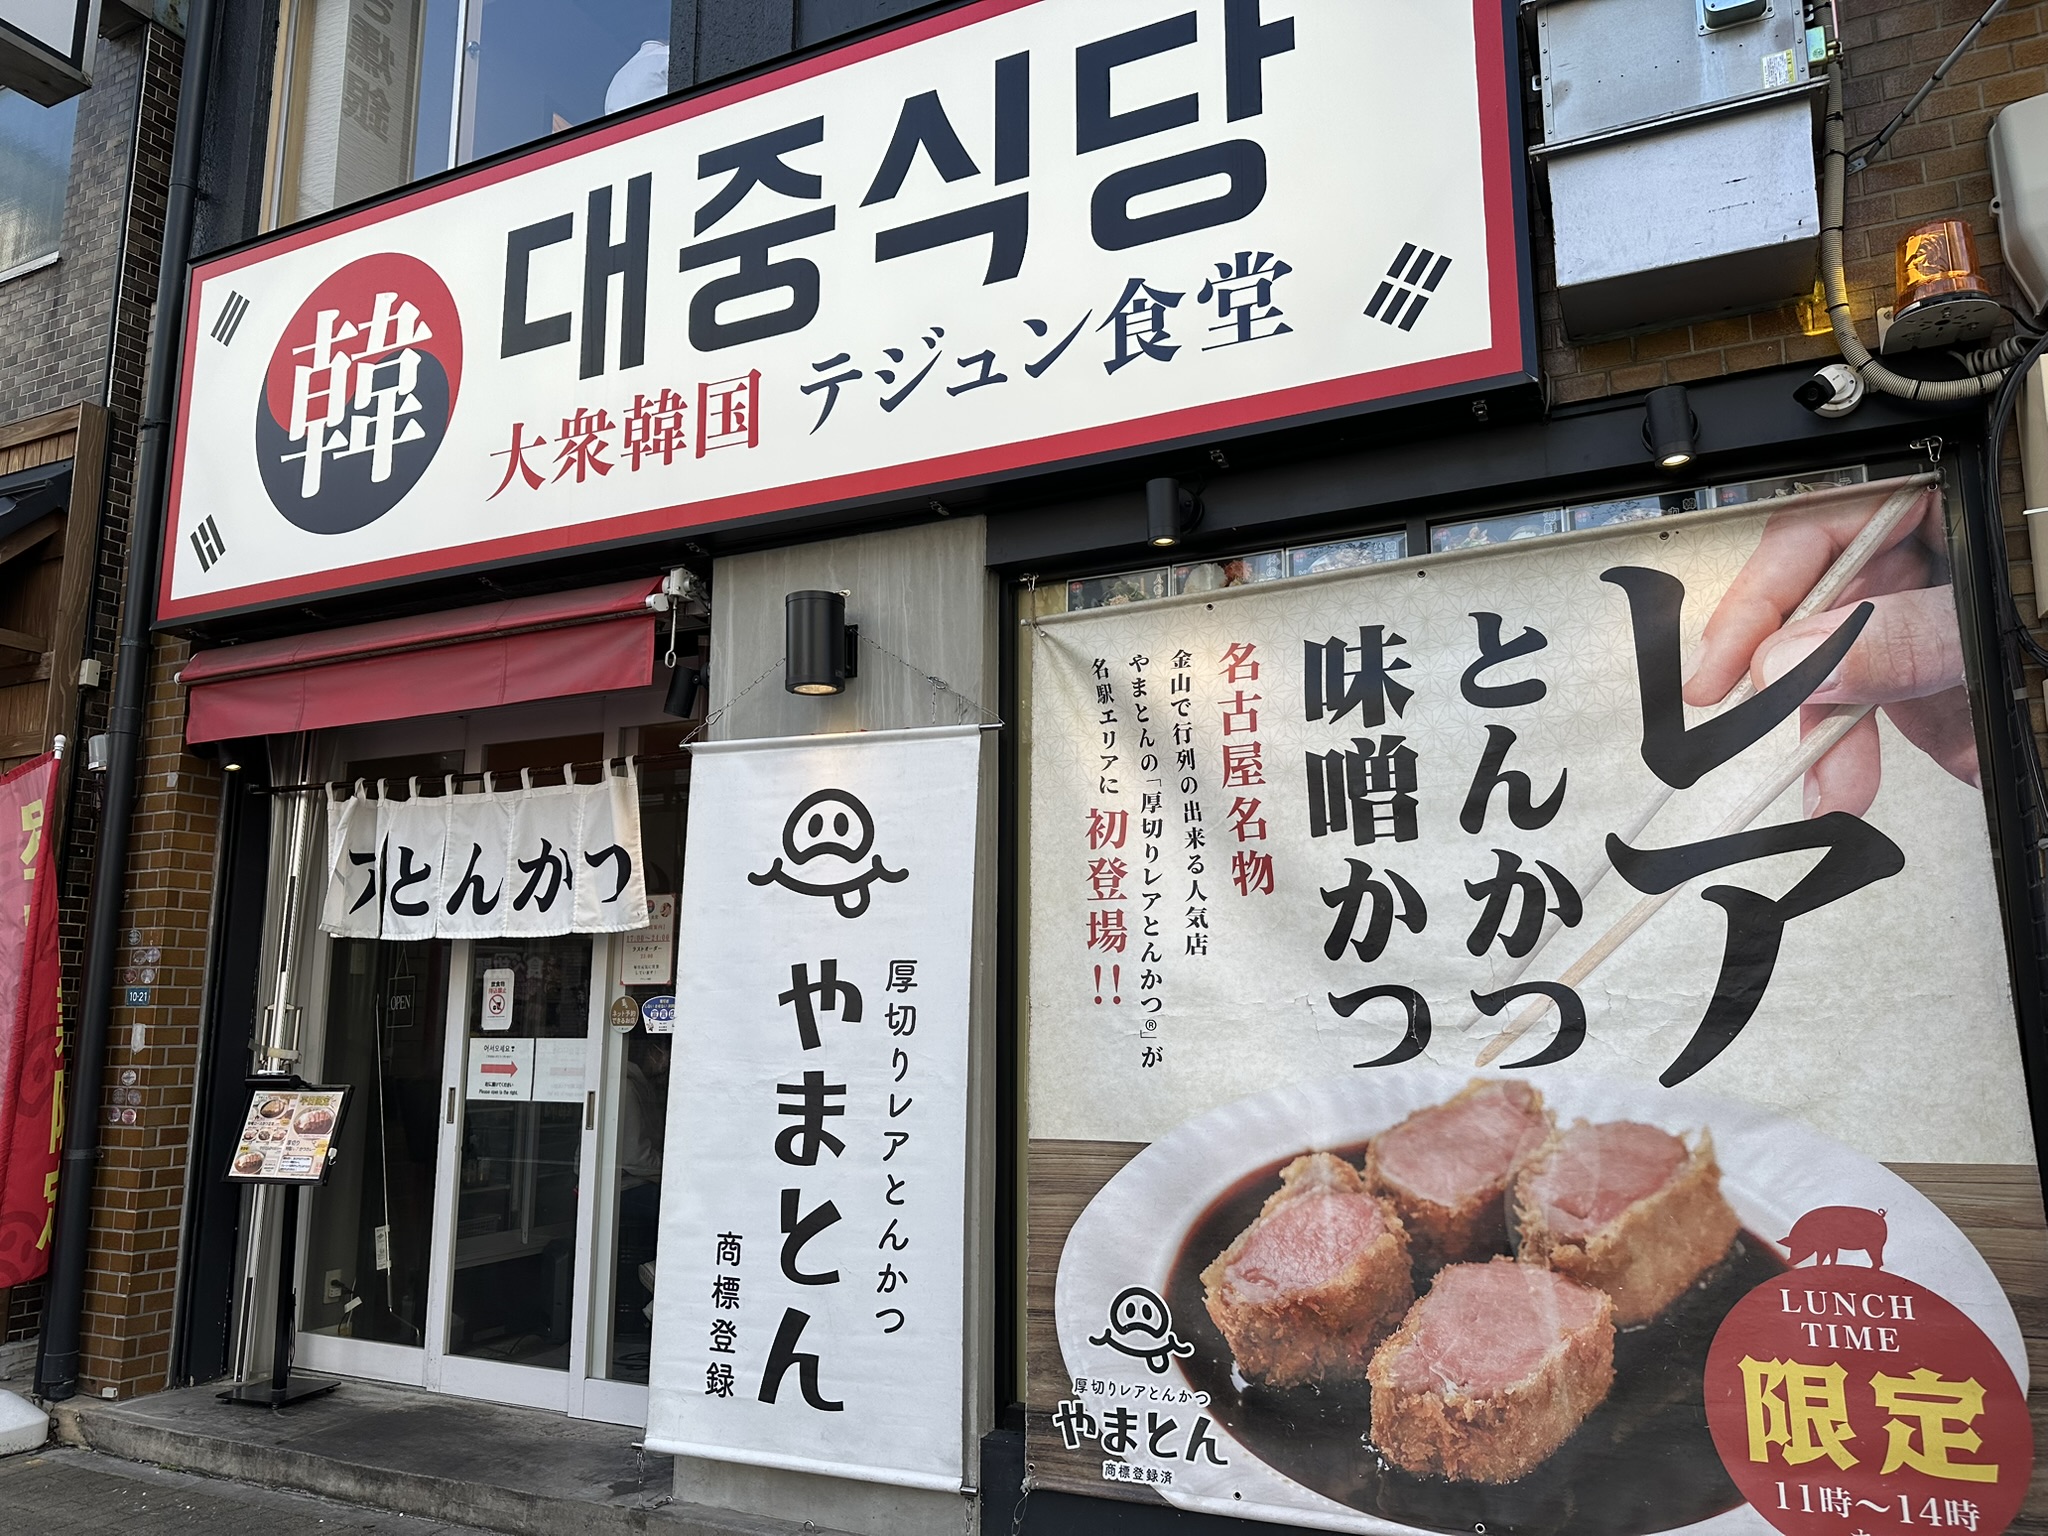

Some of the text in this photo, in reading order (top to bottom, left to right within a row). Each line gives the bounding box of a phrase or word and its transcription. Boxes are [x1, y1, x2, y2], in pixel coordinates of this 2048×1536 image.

[500, 0, 1295, 381] 대중식당
[280, 291, 433, 499] 韓
[485, 251, 1295, 502] 大衆韓国 テジュン食堂
[1170, 649, 1209, 957] 金山で行列の出来る人気店
[1218, 642, 1276, 897] 名古屋名物
[1303, 624, 1432, 1069] 味噌かつ
[1459, 612, 1588, 1070] とんかつ
[1599, 566, 1906, 1088] レア
[129, 992, 148, 1002] 10-21
[391, 995, 411, 1010] OPEN
[757, 959, 863, 1412] やまとん
[875, 960, 919, 1334] 厚切りレアとんかつ
[705, 1232, 743, 1398] 商標登録
[1073, 1377, 1209, 1405] 厚切りレアとんかつ
[1779, 1288, 1916, 1320] LUNCH
[1801, 1322, 1900, 1352] TIME
[1054, 1402, 1228, 1465] やまとん
[1104, 1463, 1172, 1485] 商標登録済
[1737, 1354, 1999, 1483] 限定
